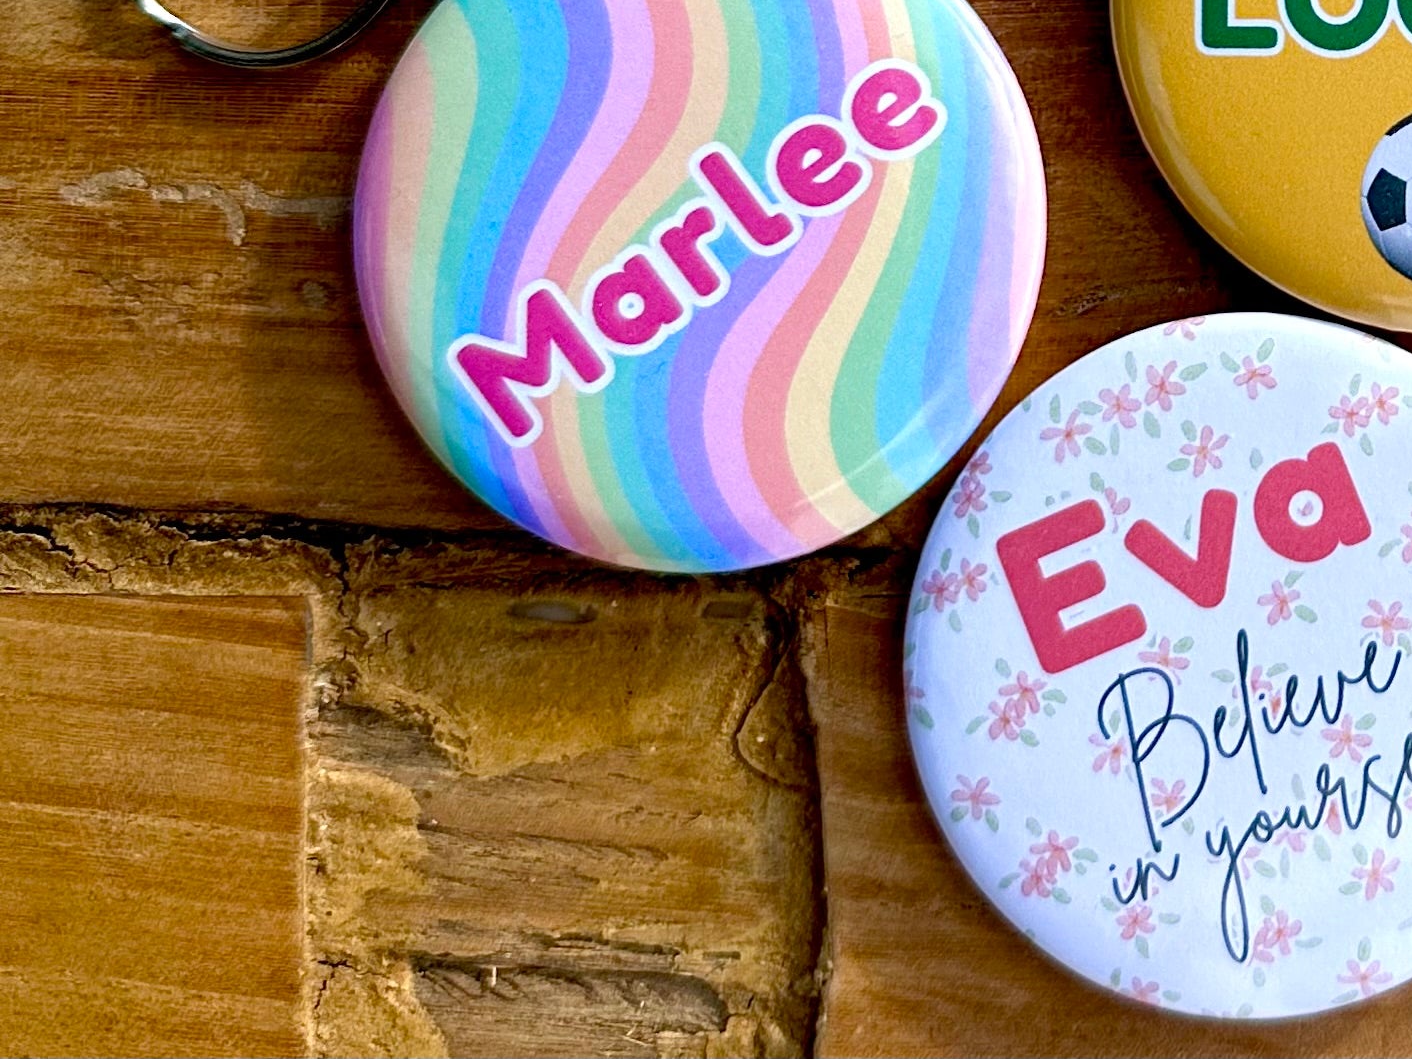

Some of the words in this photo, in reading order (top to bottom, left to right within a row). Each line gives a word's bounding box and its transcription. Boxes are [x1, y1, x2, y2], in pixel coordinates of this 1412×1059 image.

[447, 58, 948, 448] Marlee
[996, 441, 1372, 674] Eva
[1098, 629, 1401, 852] Believe
[1108, 854, 1180, 904] in
